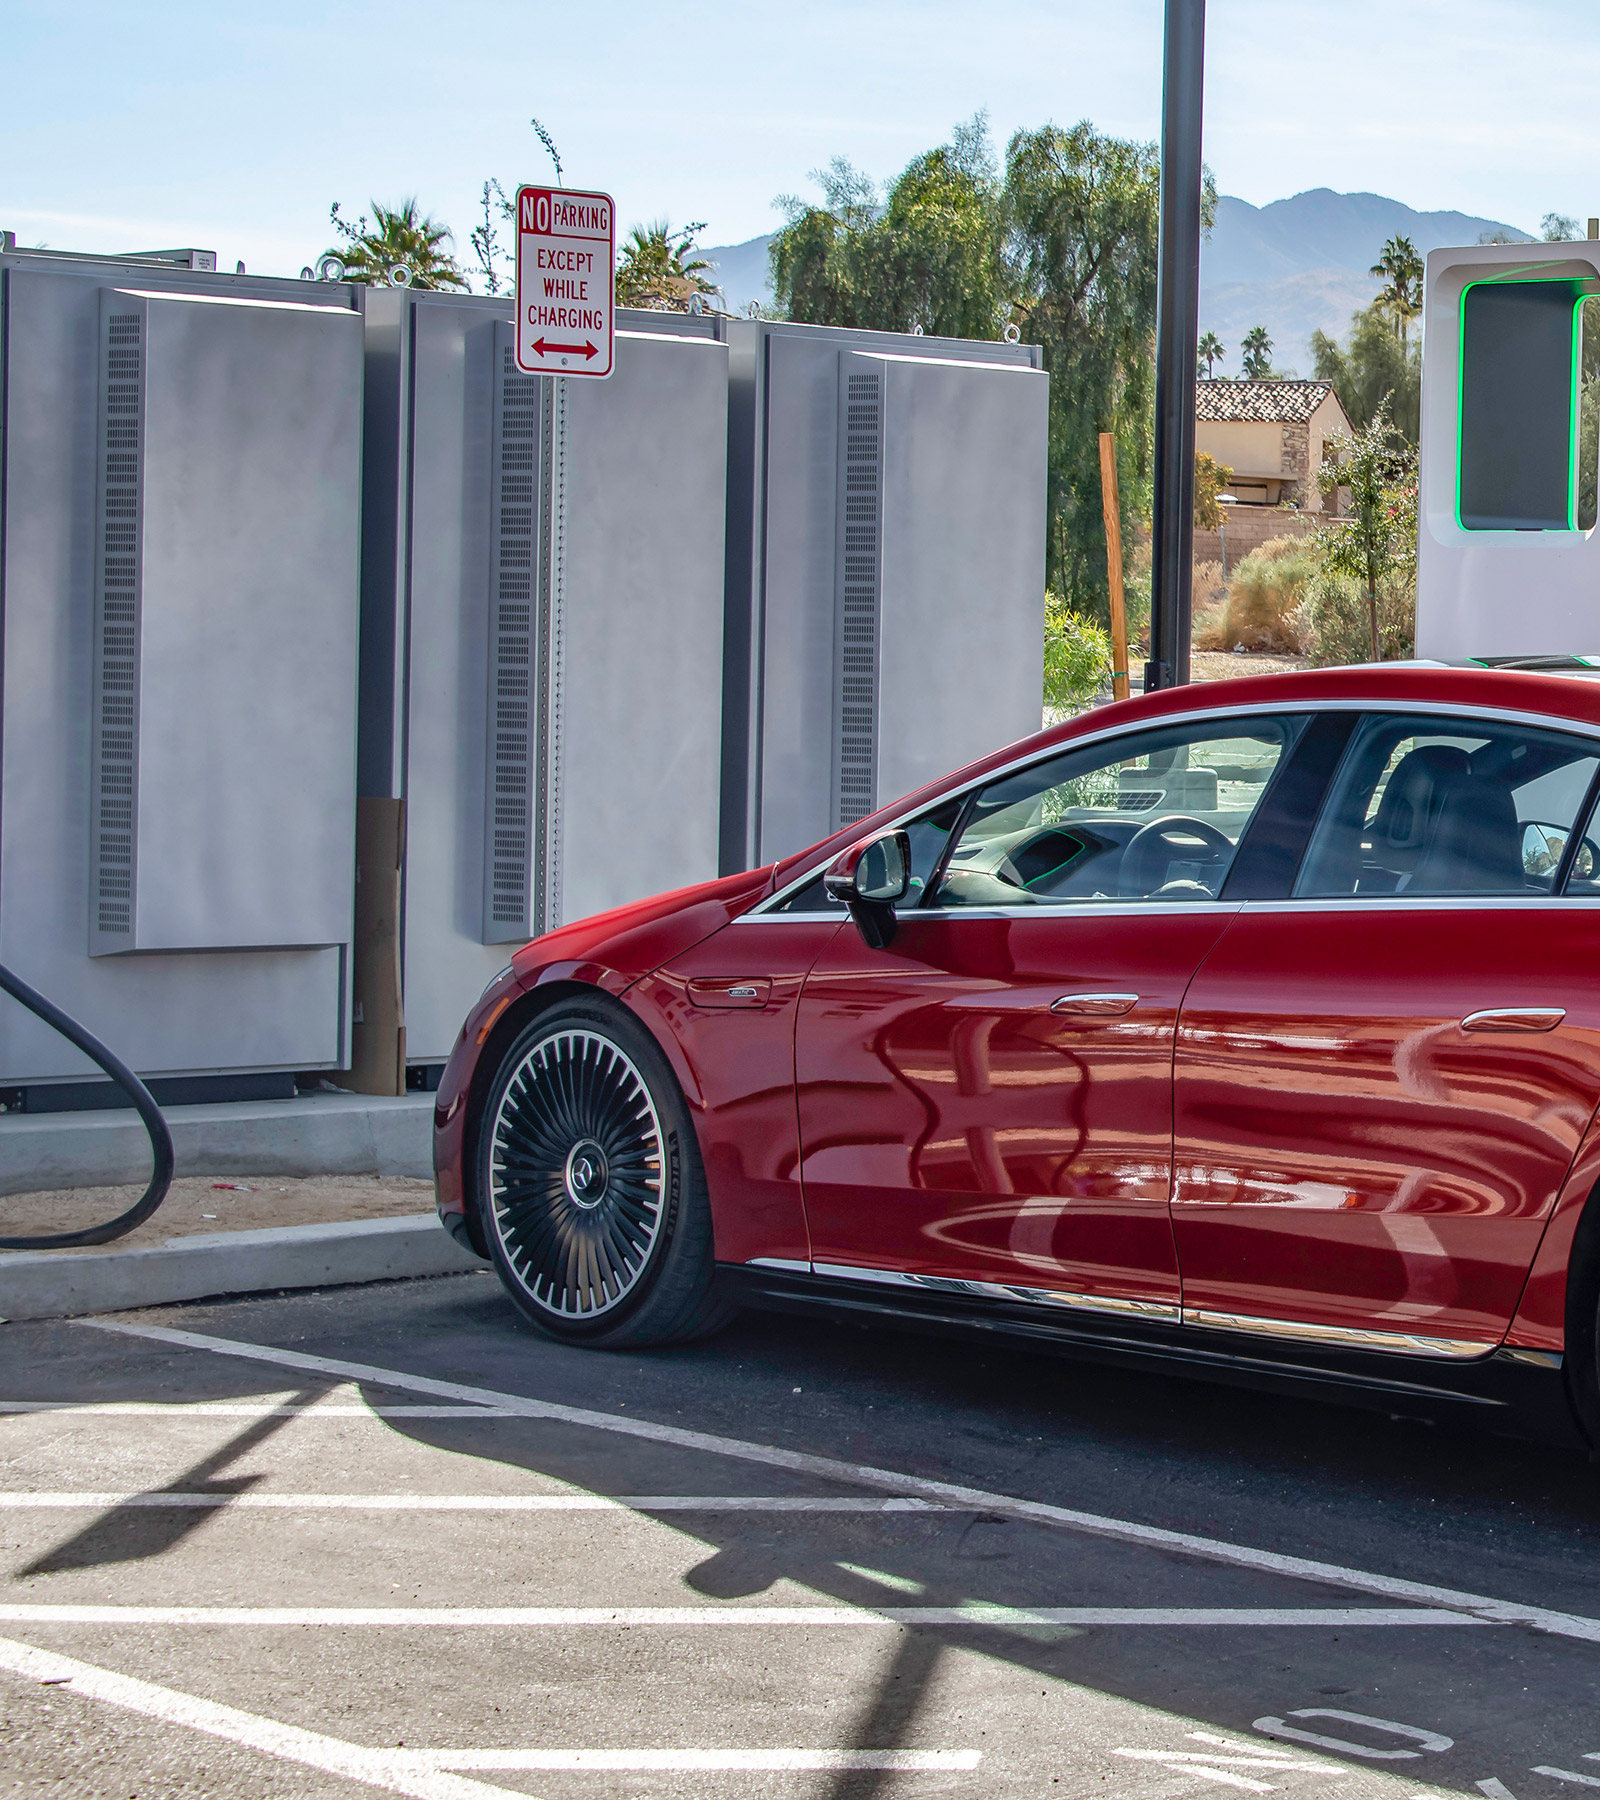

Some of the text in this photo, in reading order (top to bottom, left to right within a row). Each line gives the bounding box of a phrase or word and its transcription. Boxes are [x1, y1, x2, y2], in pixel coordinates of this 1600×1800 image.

[522, 195, 608, 232] NO PARKING
[537, 248, 594, 273] EXCEPT
[543, 277, 589, 301] WHILE
[528, 305, 603, 331] CHARGING
